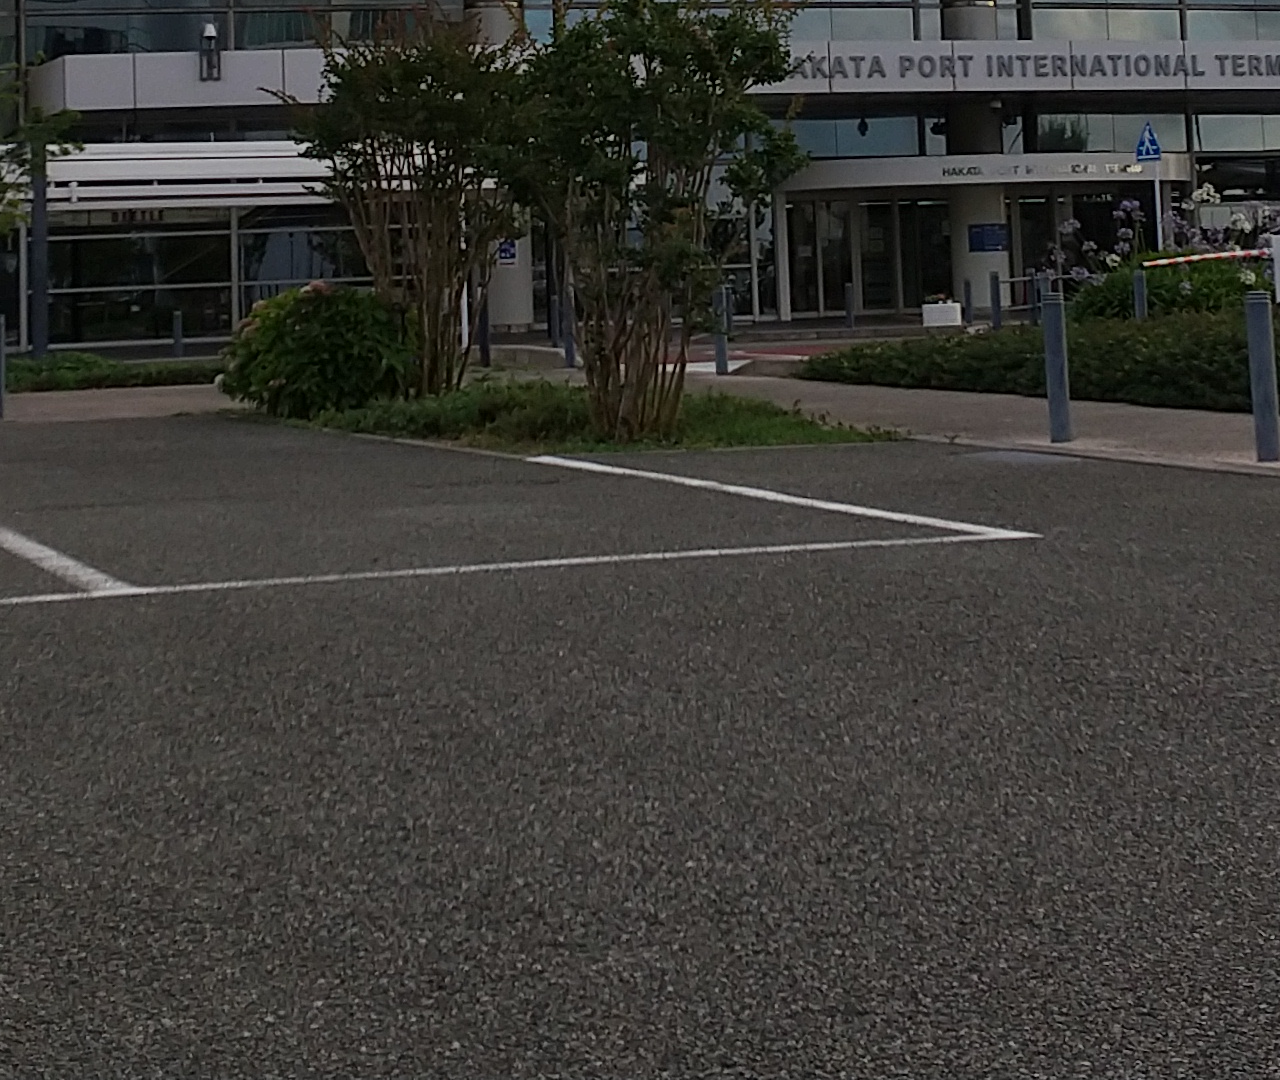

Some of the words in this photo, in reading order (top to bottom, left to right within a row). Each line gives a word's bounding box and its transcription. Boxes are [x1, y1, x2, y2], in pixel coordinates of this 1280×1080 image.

[789, 54, 888, 79] AKATA
[898, 54, 974, 78] PORT
[986, 54, 1206, 78] INTERNATIONAL
